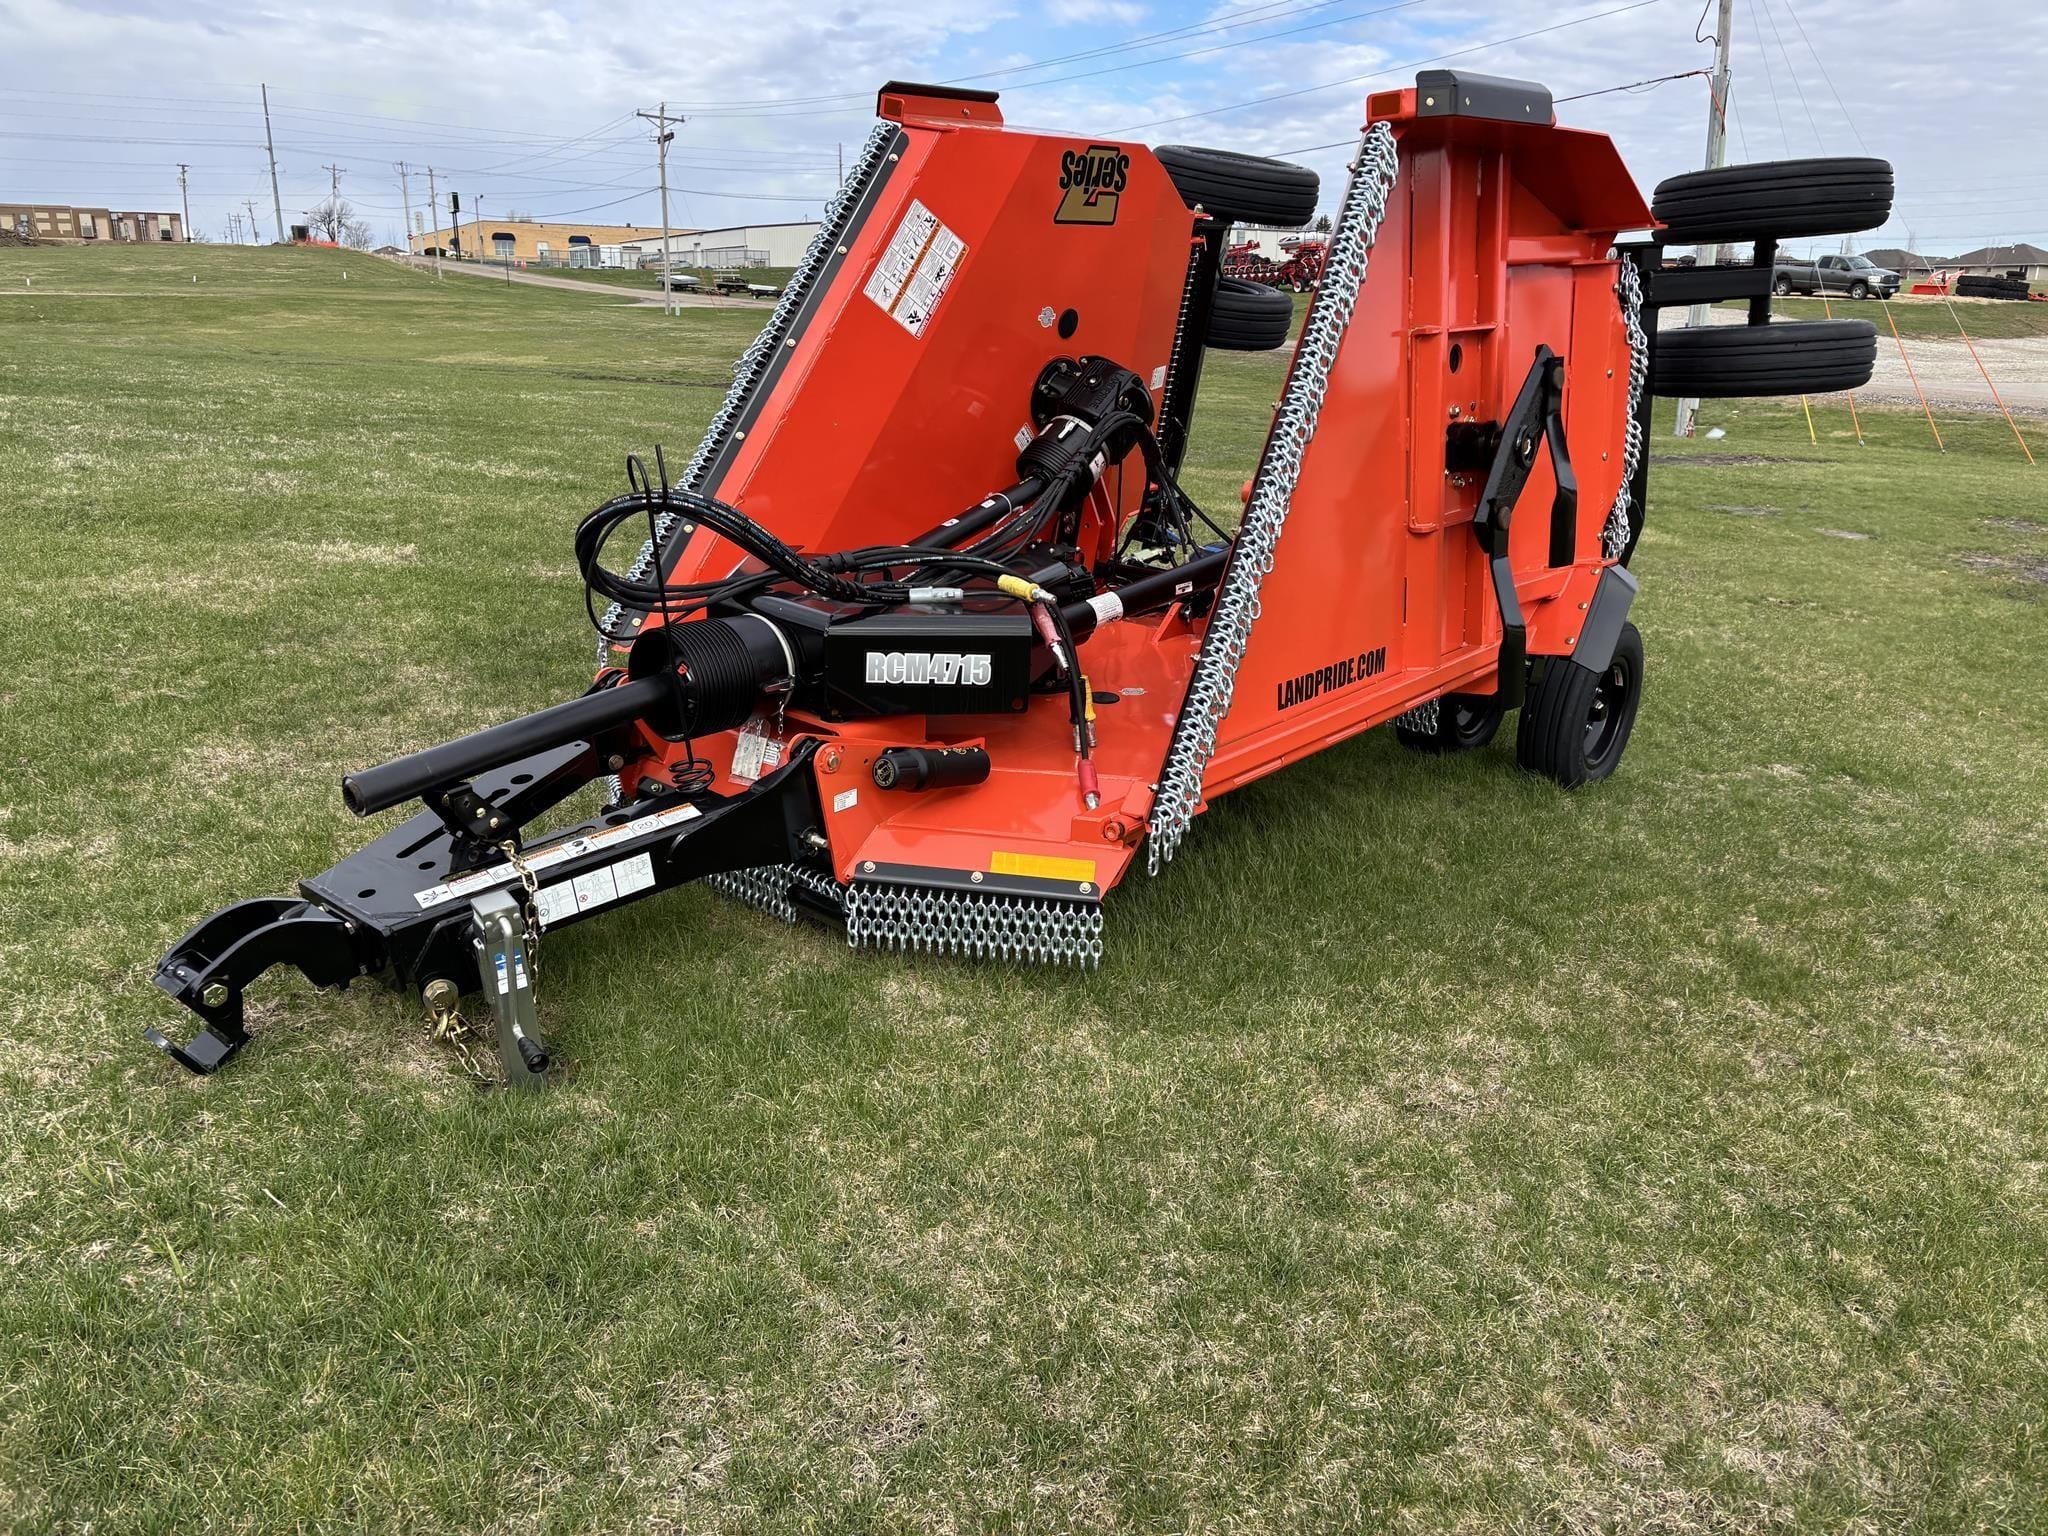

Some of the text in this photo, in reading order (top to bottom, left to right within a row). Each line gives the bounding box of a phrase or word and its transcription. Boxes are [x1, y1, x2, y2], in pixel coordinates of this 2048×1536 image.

[1059, 150, 1130, 193] series
[865, 651, 992, 686] RCM4715
[1277, 646, 1387, 711] LANDPRIDE.COM
